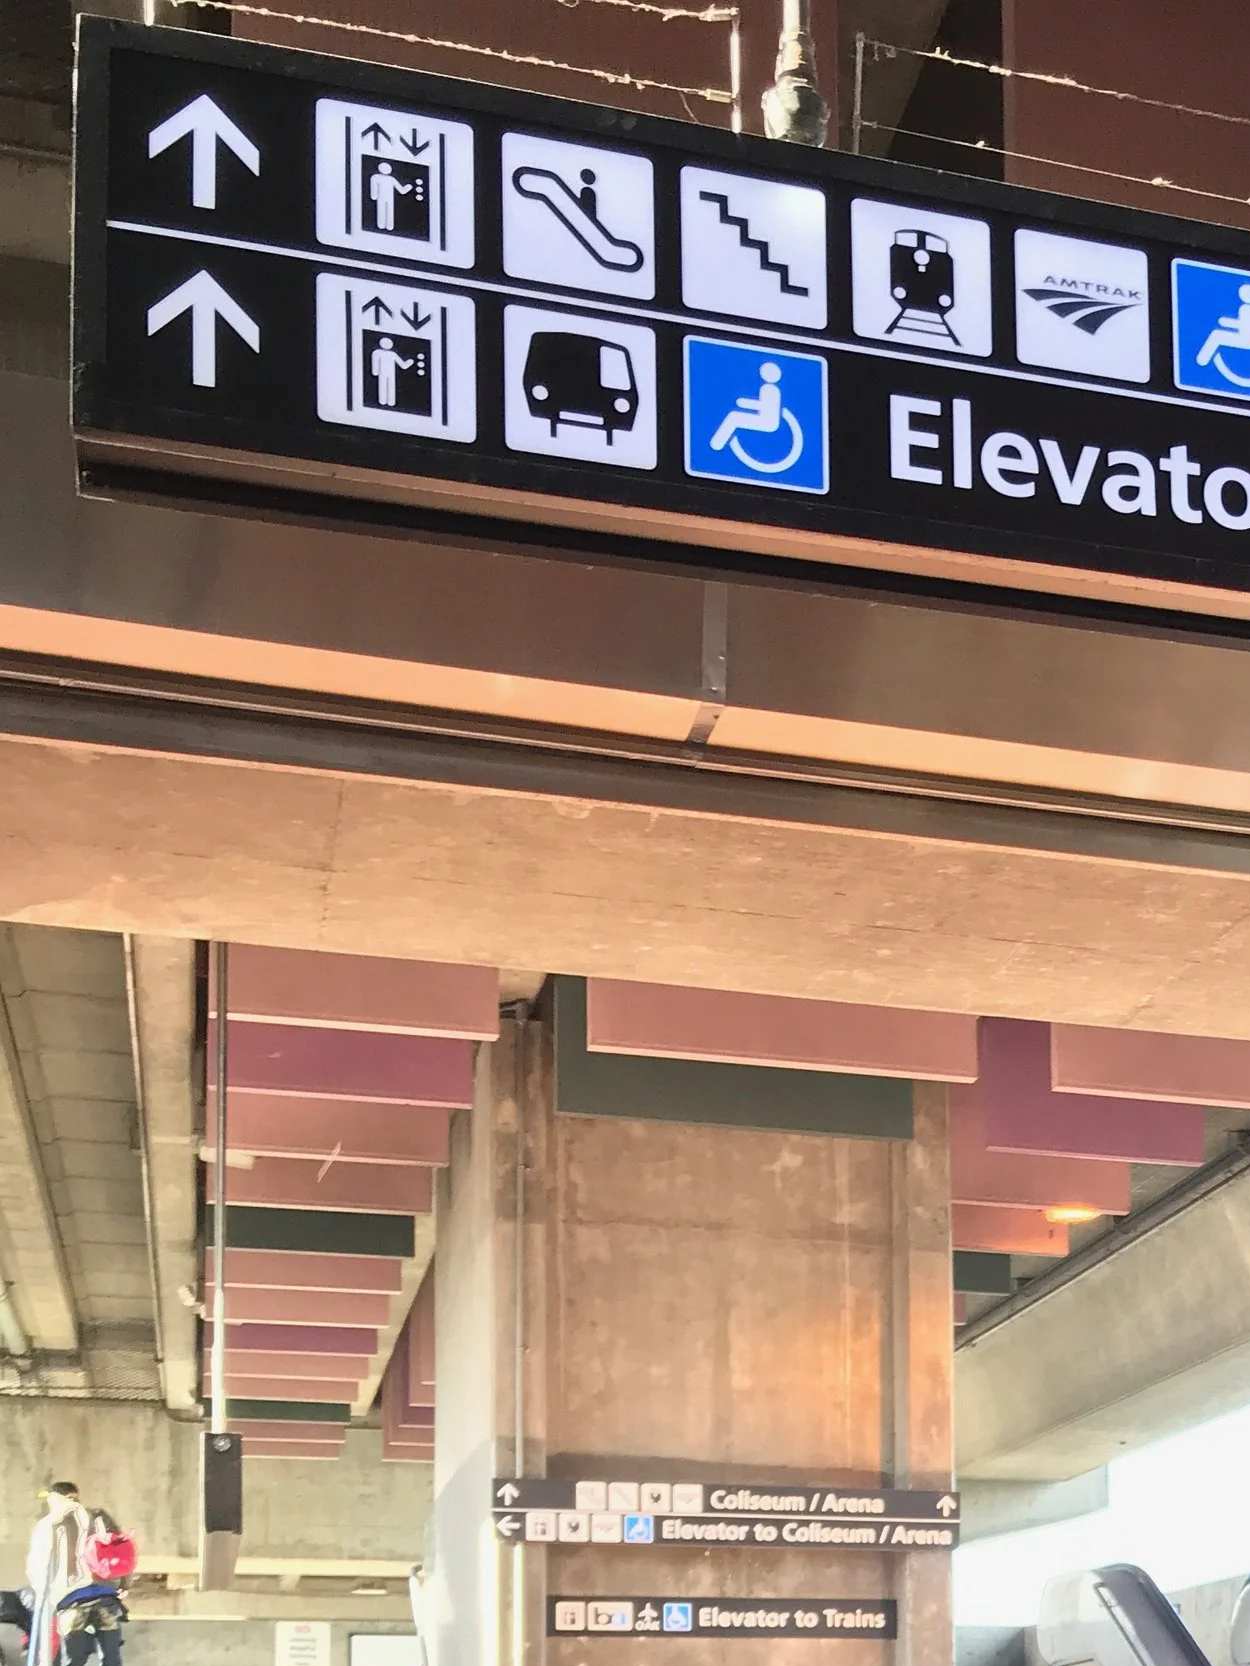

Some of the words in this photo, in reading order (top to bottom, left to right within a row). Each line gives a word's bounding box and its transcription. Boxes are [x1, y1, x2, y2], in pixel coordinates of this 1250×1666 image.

[1043, 275, 1142, 300] AMTRAK
[710, 1489, 806, 1512] Coliseum
[821, 1493, 885, 1514] Arena
[662, 1519, 749, 1541] Elevator
[753, 1523, 778, 1542] to
[782, 1522, 876, 1544] Coliseum
[891, 1525, 952, 1545] Arena
[699, 1606, 790, 1628] Elevator
[794, 1610, 819, 1628] to
[823, 1608, 886, 1629] Trains
